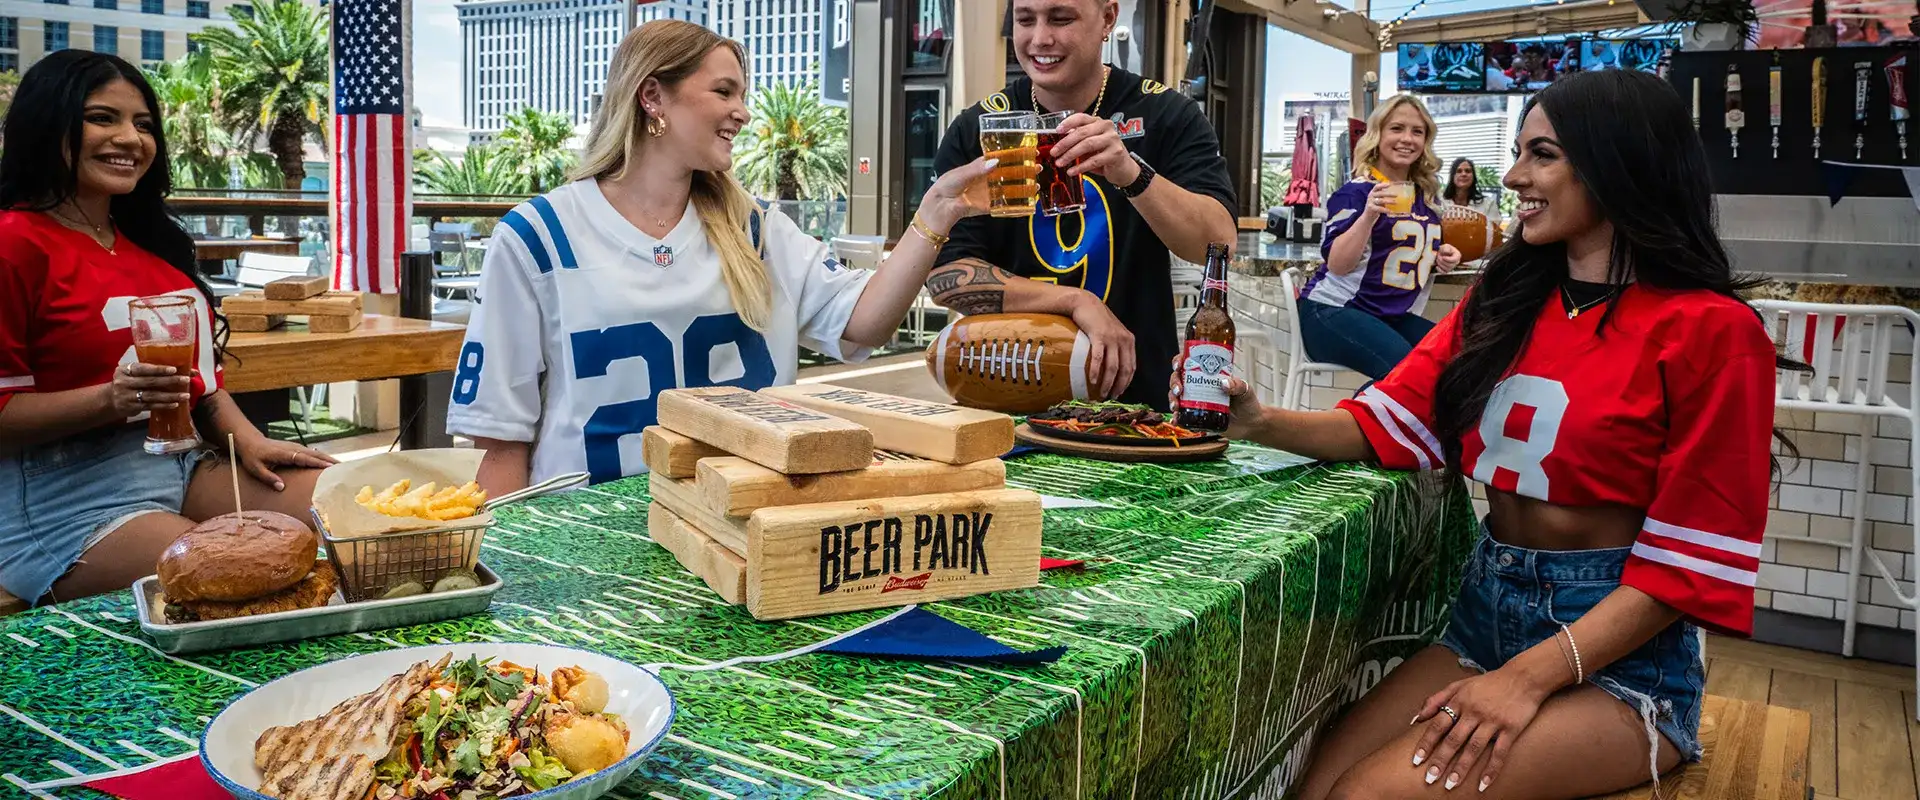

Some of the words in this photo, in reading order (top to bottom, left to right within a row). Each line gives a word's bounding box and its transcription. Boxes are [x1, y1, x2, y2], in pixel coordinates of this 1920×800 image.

[655, 254, 673, 265] NFL
[453, 341, 485, 405] 8
[1473, 373, 1570, 501] 8
[819, 517, 903, 595] BEER
[913, 512, 993, 576] PARK
